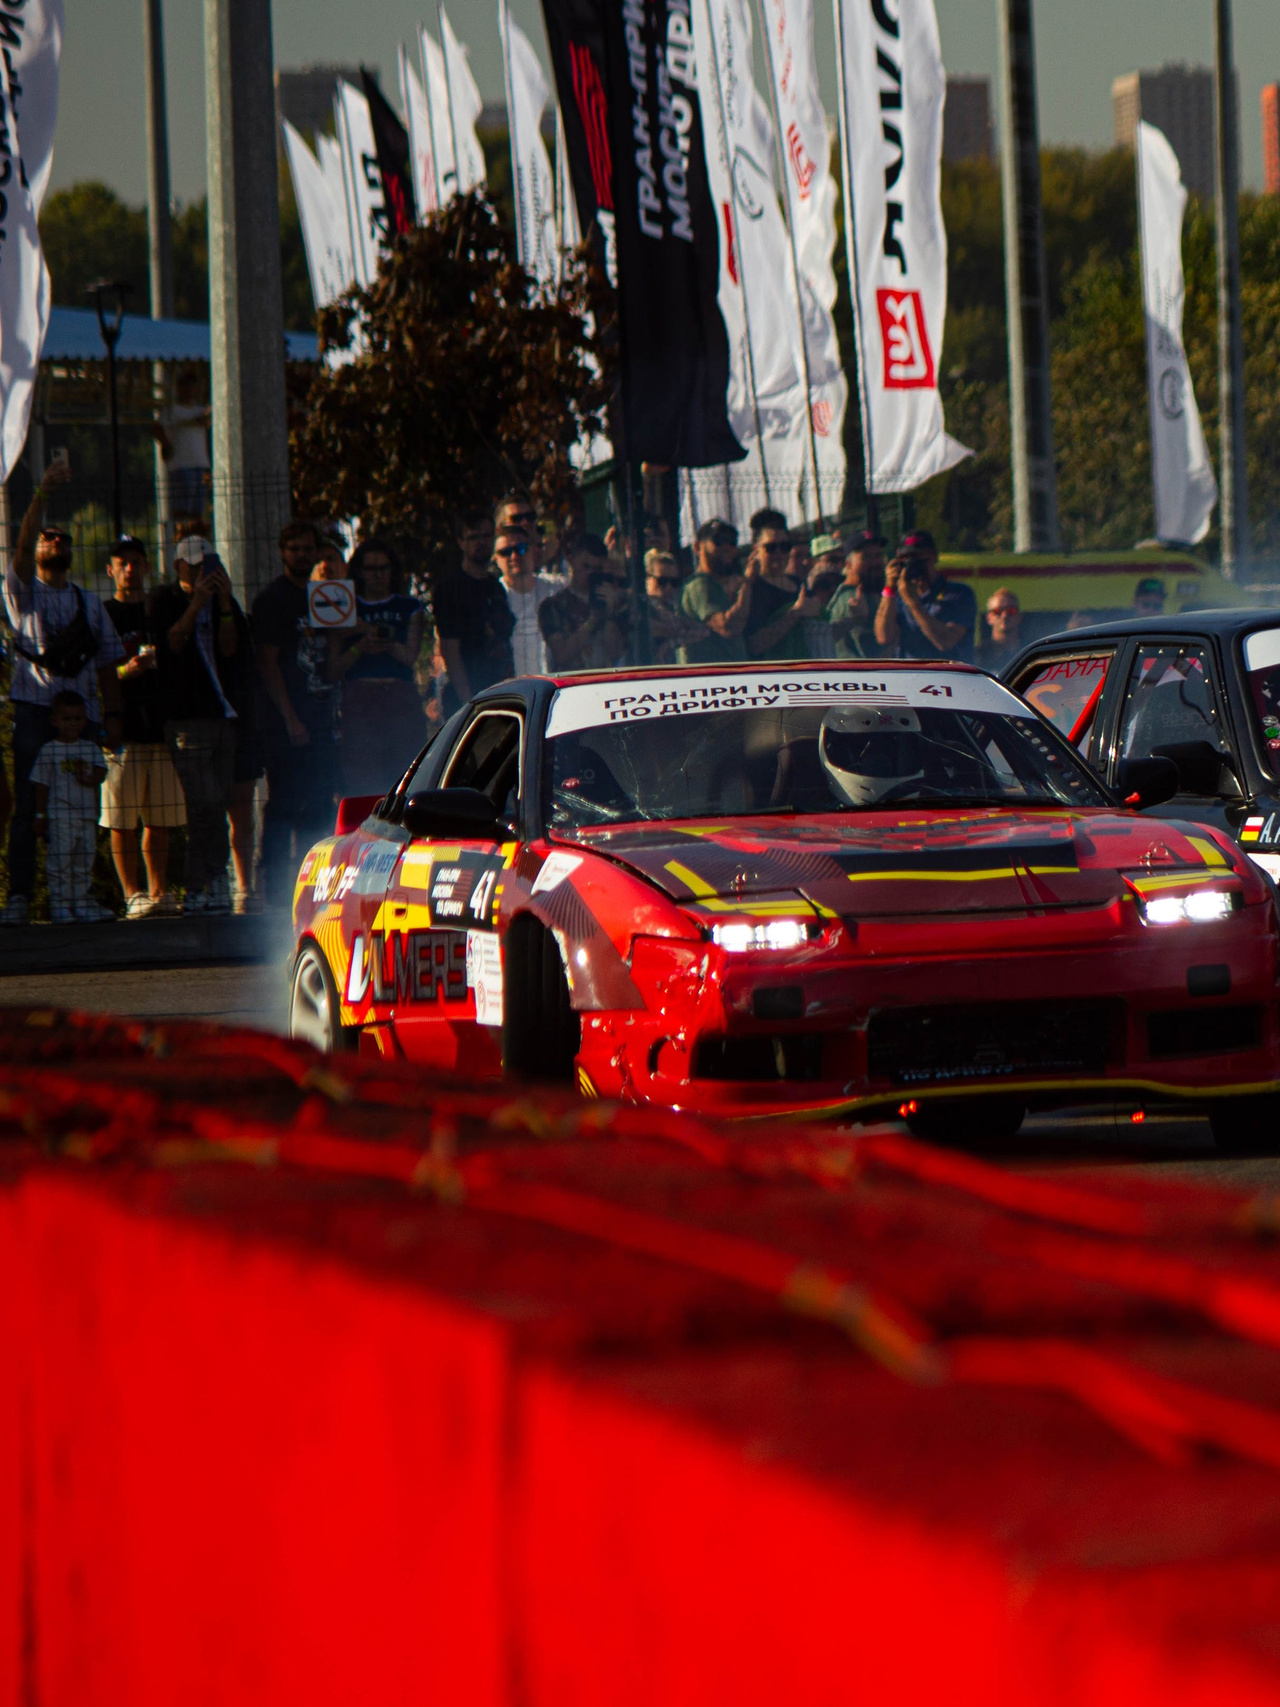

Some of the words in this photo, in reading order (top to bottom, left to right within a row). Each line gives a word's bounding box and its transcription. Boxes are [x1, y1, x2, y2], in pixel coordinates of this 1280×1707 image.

[603, 684, 748, 710] ГРАН-ПРИ
[757, 681, 887, 695] МОСКВЫ
[918, 684, 954, 698] 41
[609, 705, 652, 721] ПО
[658, 695, 782, 716] ДРИФТУ
[1258, 812, 1273, 844] А.
[470, 870, 496, 920] 41
